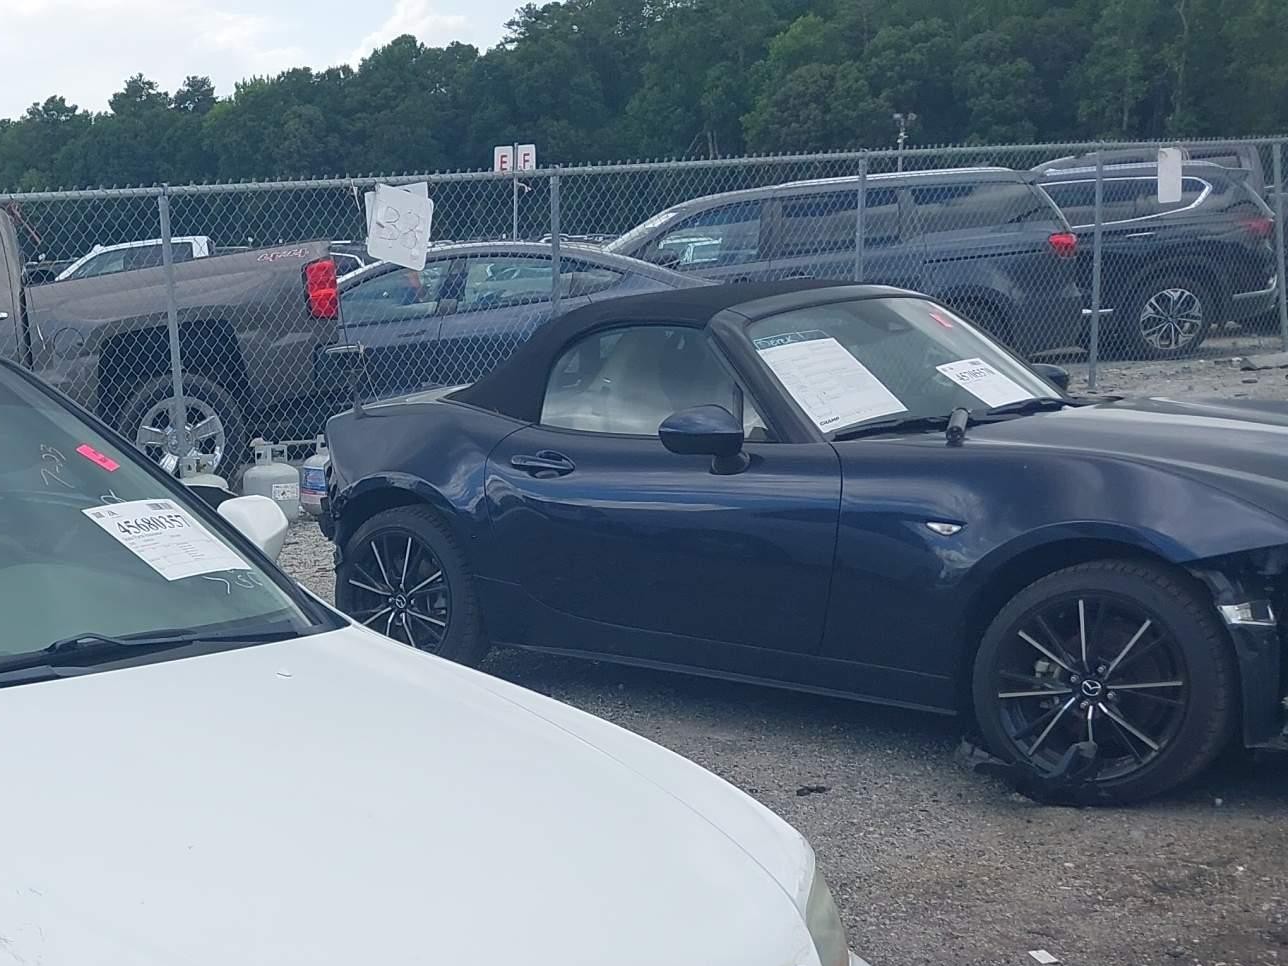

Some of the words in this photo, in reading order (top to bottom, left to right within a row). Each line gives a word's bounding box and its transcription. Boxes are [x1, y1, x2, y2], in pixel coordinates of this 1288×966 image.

[499, 154, 508, 171] E
[522, 152, 531, 169] F
[115, 514, 191, 536] 45680357
